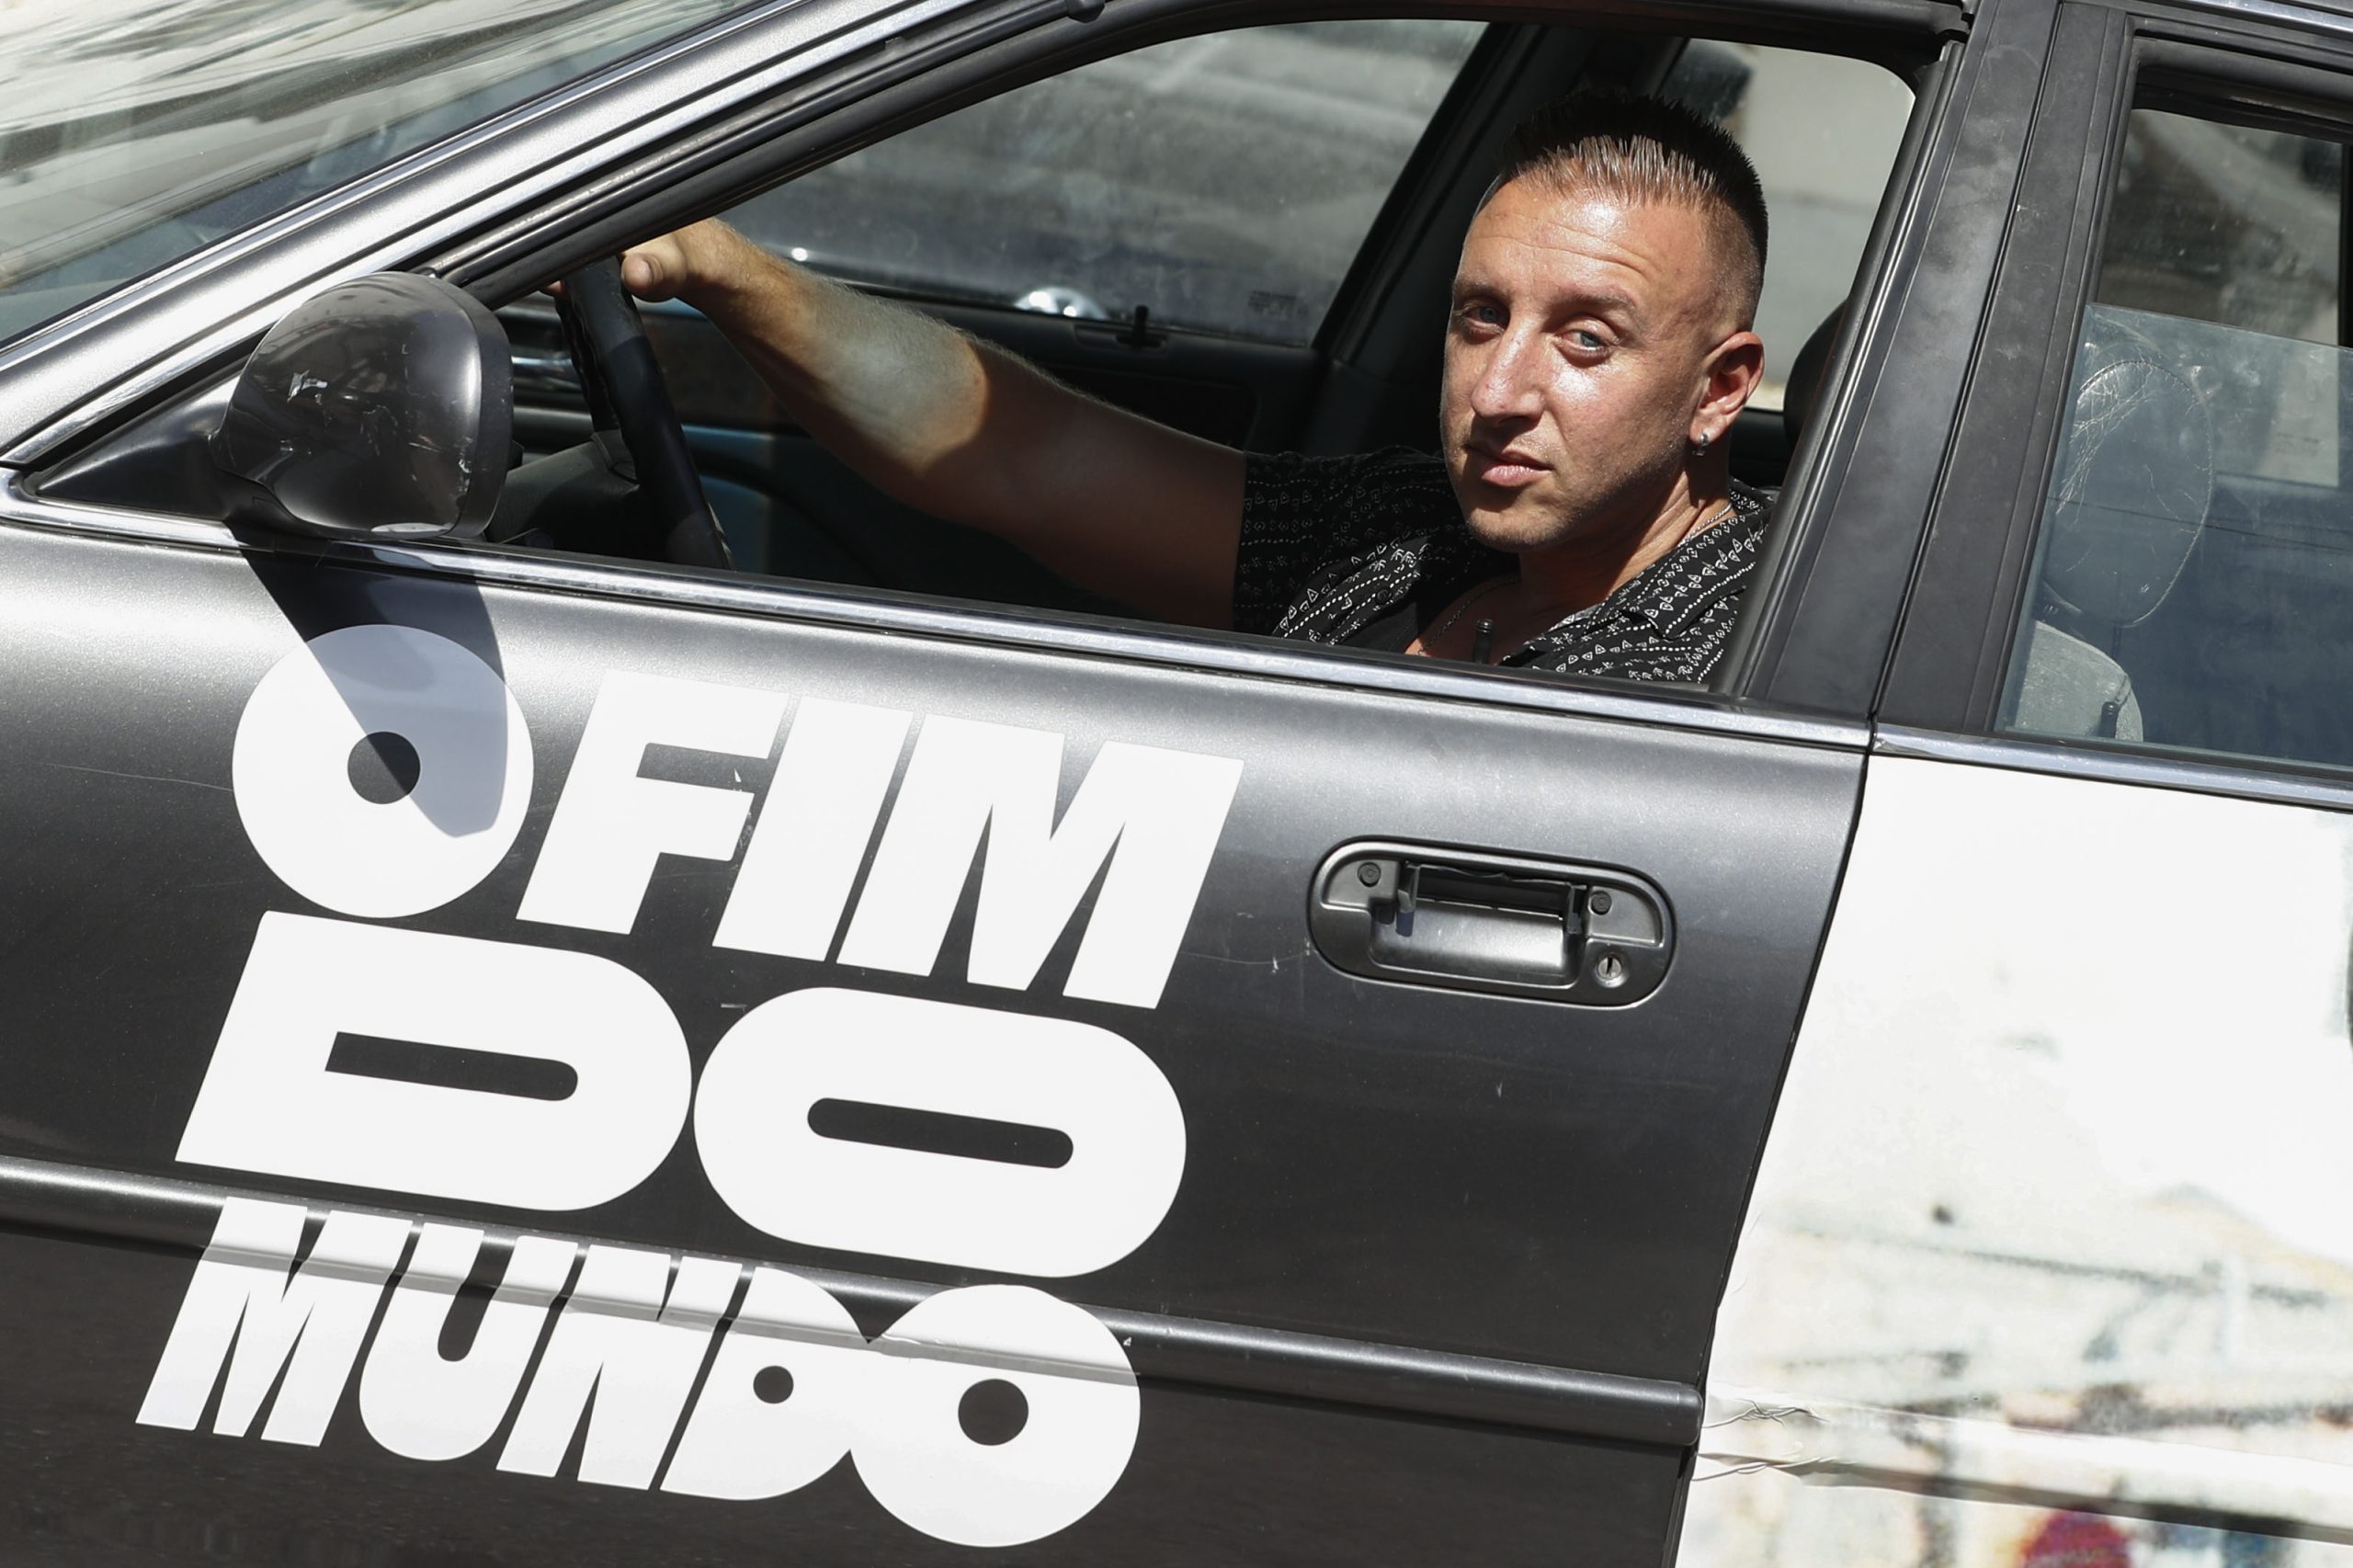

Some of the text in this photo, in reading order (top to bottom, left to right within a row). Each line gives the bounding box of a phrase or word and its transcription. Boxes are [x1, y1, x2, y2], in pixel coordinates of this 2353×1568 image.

[233, 624, 1244, 1009] O FIM
[176, 911, 1186, 1278] DO
[136, 1197, 1141, 1548] MUNDO
